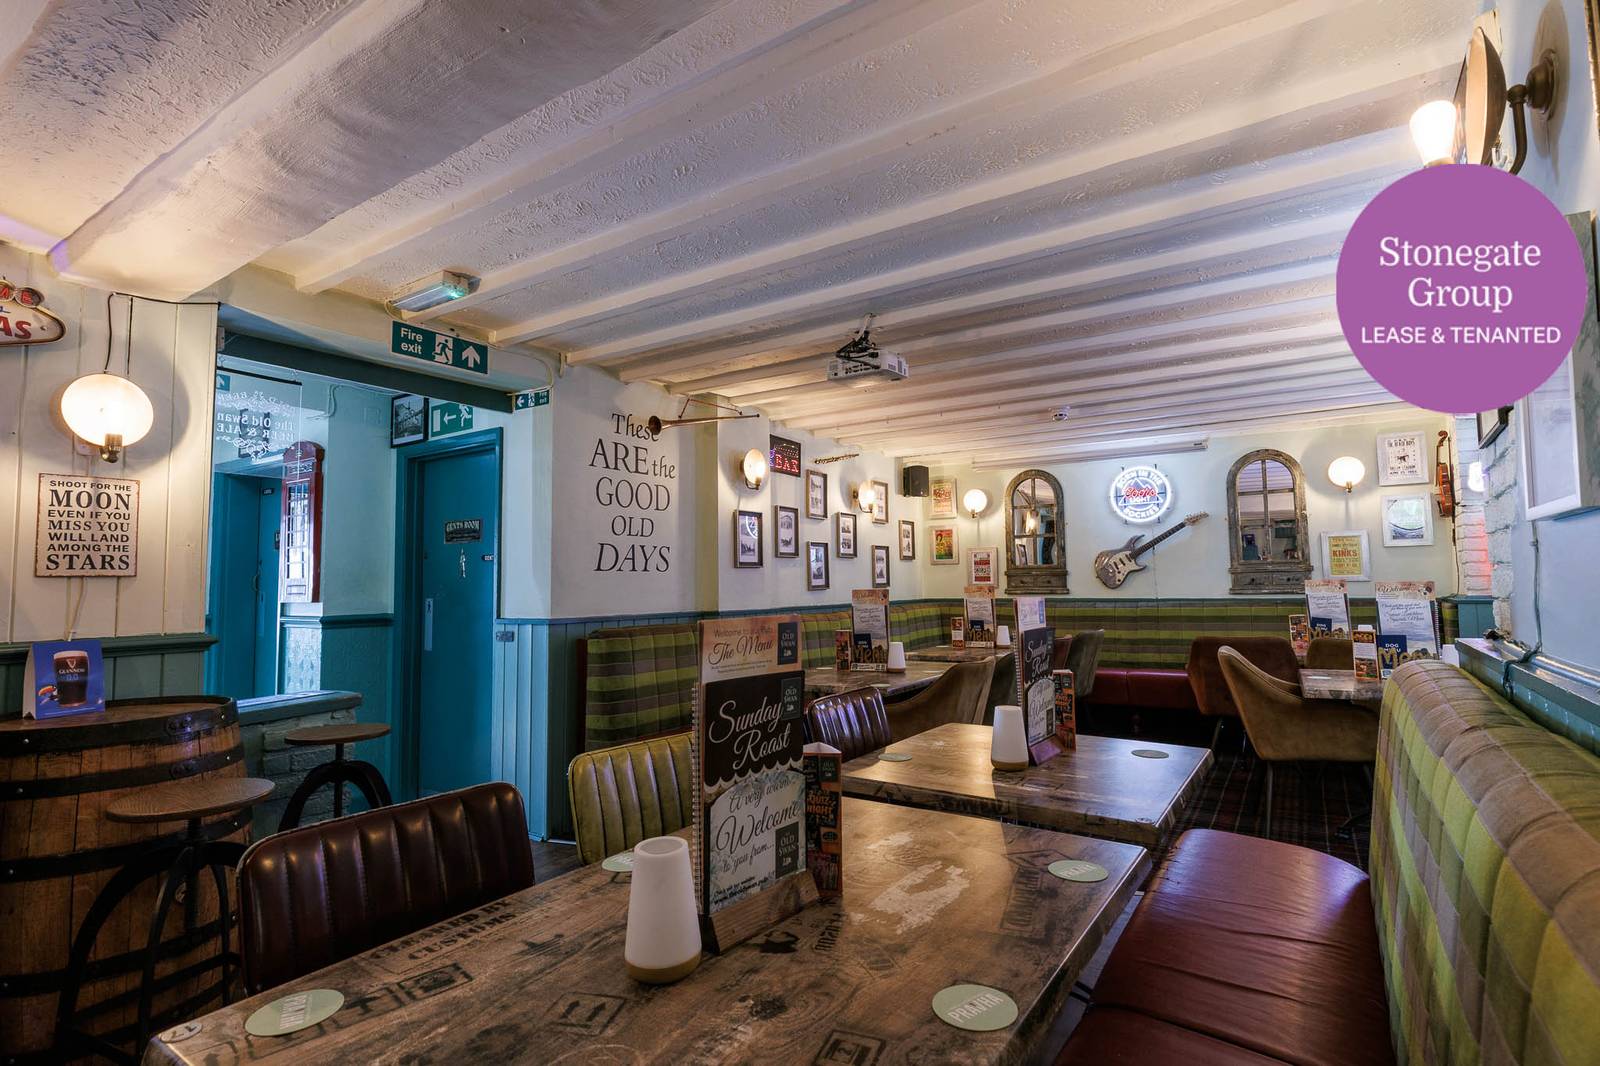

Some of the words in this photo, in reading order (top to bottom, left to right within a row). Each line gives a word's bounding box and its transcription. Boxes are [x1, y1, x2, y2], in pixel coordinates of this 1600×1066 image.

[400, 327, 423, 343] Fire
[400, 341, 422, 355] exit
[589, 438, 649, 476] ARE
[651, 455, 676, 479] the
[775, 453, 799, 473] BAR
[49, 480, 87, 488] SHOOT
[90, 482, 111, 490] FOR
[113, 484, 132, 492] THE
[596, 476, 671, 512] GOOD
[48, 489, 131, 511] MOON
[48, 509, 85, 518] EVEN
[90, 511, 102, 519] IF
[105, 512, 131, 521] YOU
[48, 520, 92, 531] MISS
[97, 521, 130, 532] YOU
[611, 515, 654, 538] OLD
[48, 532, 86, 541] WILL
[91, 534, 129, 543] LAND
[47, 543, 101, 552] AMONG
[105, 544, 129, 553] THE
[594, 542, 671, 573] DAYS
[1332, 549, 1358, 557] KINKS
[46, 553, 130, 571] STARS
[708, 642, 734, 666] The
[736, 634, 774, 657] Menu
[709, 696, 783, 743] Sunday
[733, 722, 791, 770] Roast
[715, 801, 800, 854] Welcome
[781, 835, 795, 845] OLD
[779, 845, 798, 857] SWAN
[408, 912, 516, 960] CUSTOMS
[948, 992, 1004, 1024] PRAVHA
